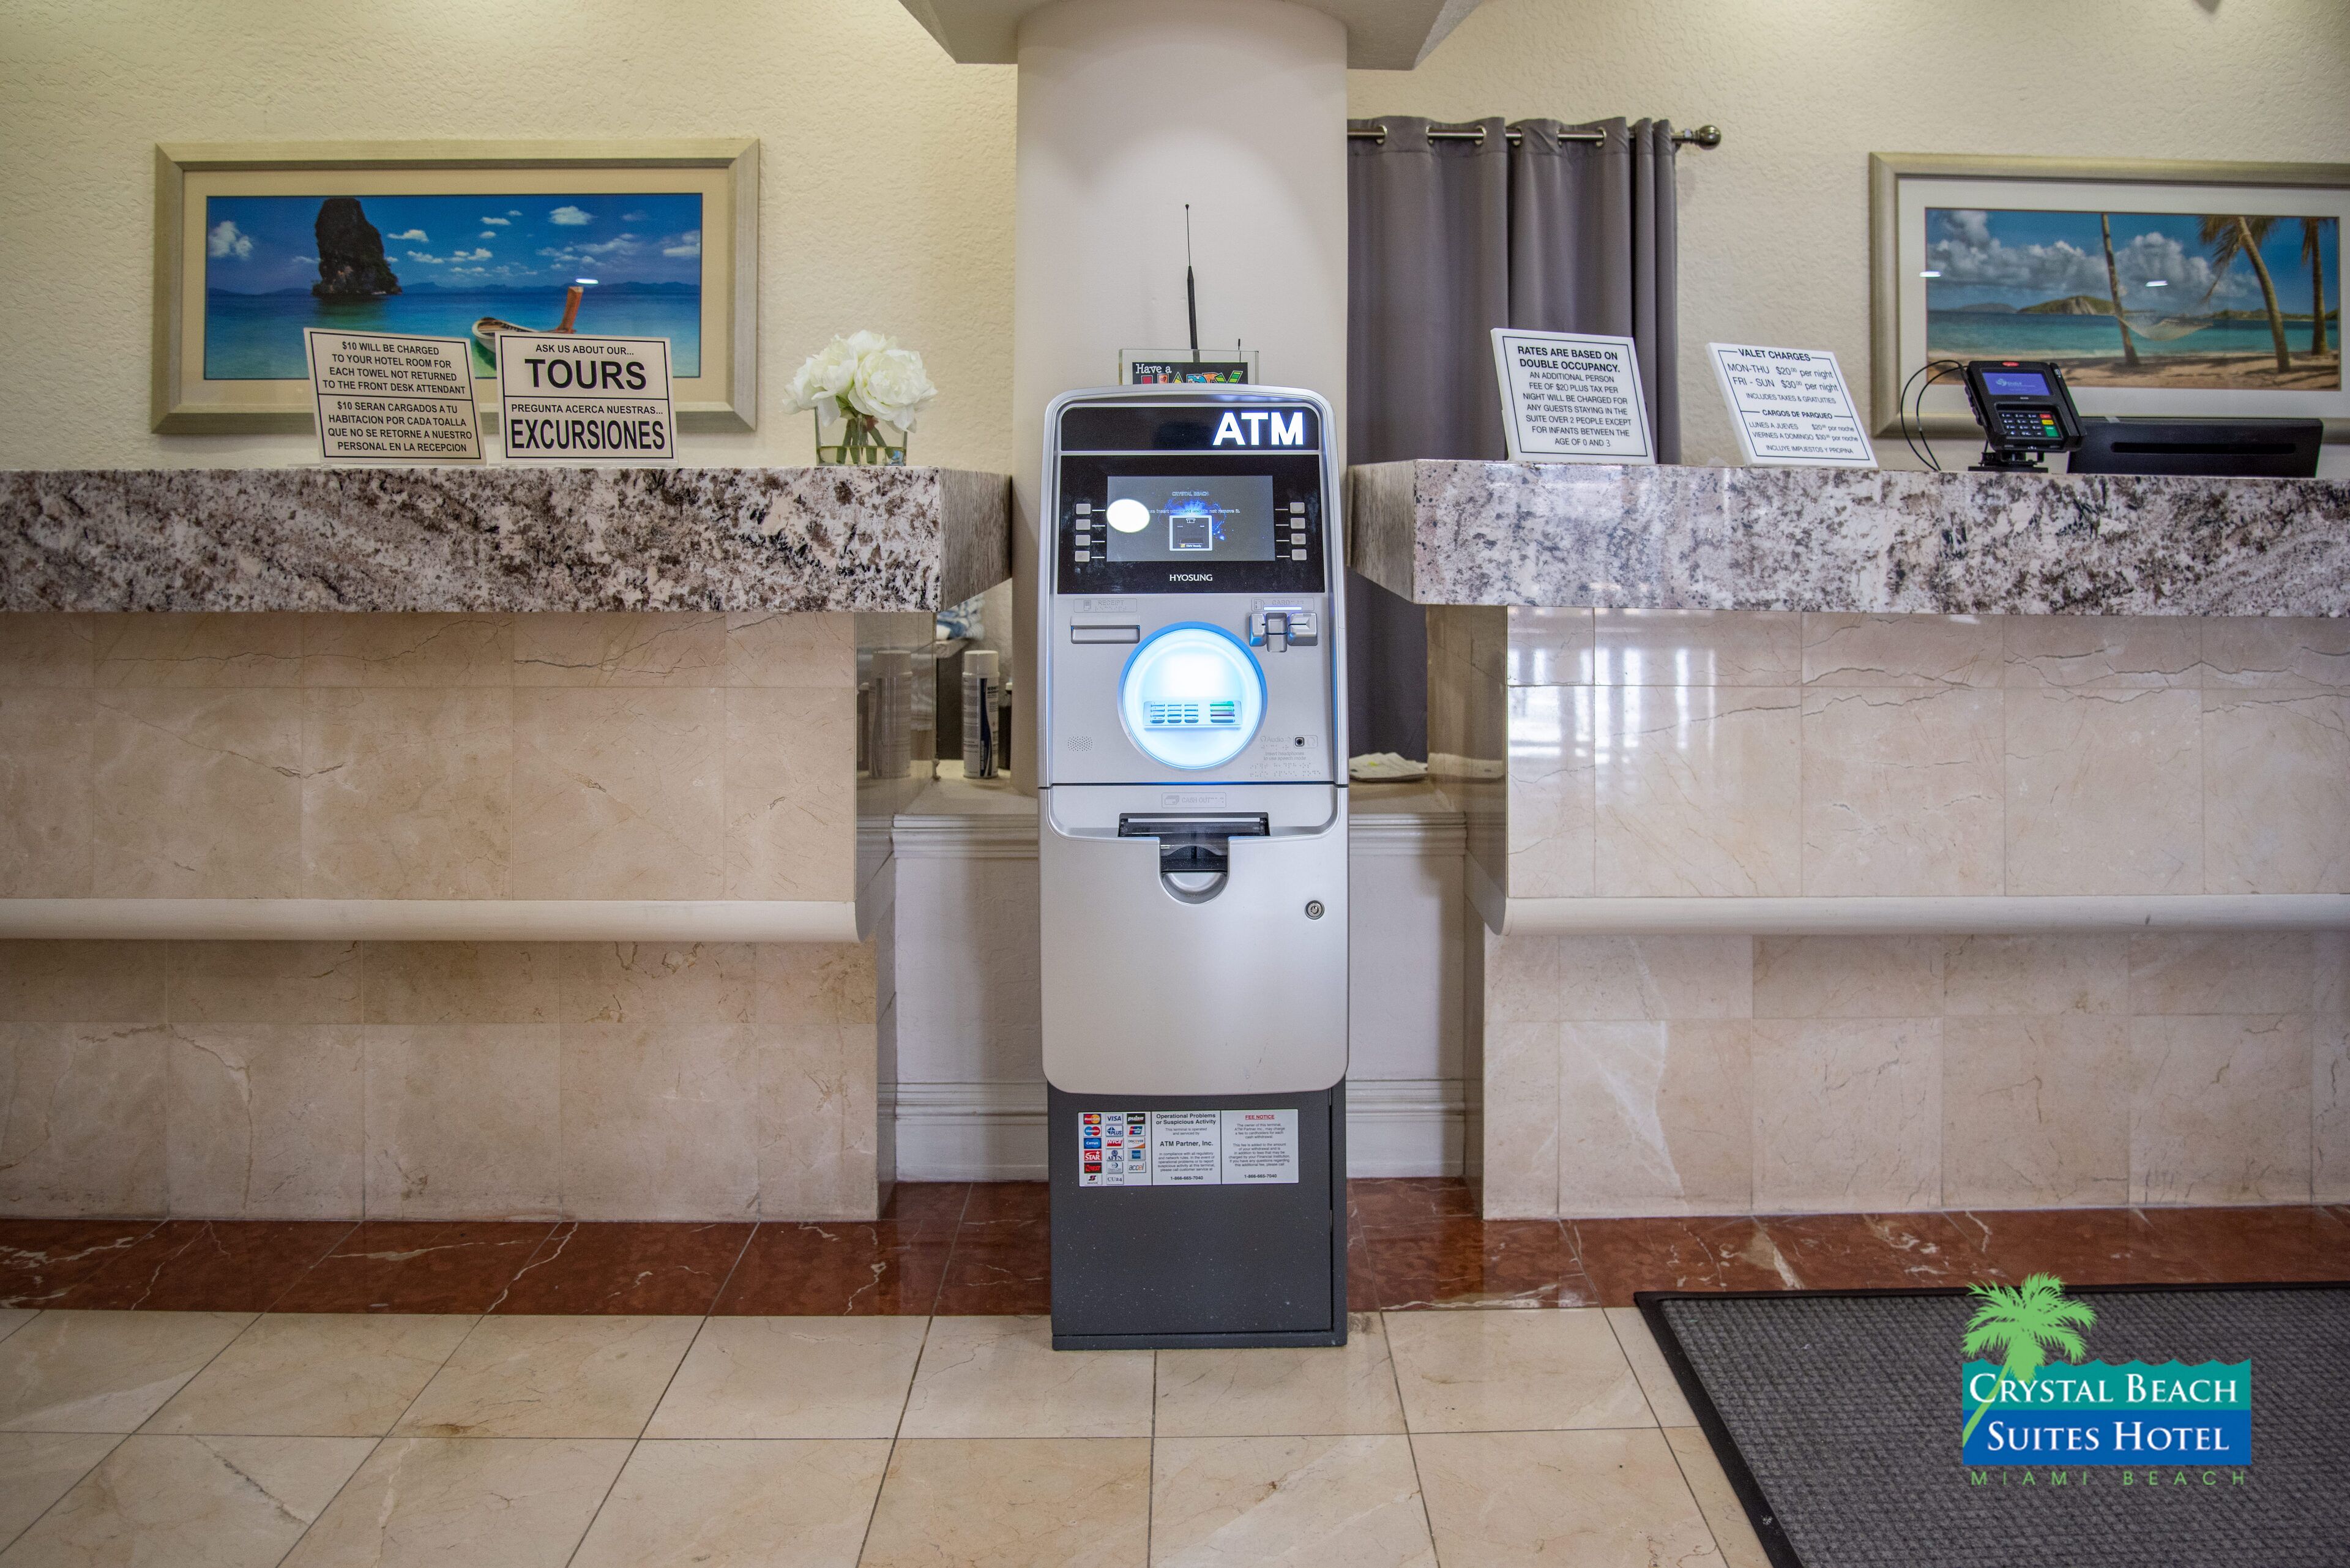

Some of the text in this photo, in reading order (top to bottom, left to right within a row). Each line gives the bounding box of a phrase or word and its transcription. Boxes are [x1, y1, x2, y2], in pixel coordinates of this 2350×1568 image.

[342, 341, 439, 356] $10 WILL BE CHARGED
[535, 344, 634, 355] ASK US ABOUT OUR...
[1517, 346, 1618, 360] RATES ARE BASED ON
[1738, 348, 1811, 362] VALET CHARGES
[331, 353, 452, 368] TO YOUR HOTEL ROOM FOR
[1519, 358, 1620, 373] DOUBLE OCCUPANCY.
[329, 367, 457, 381] EACH TOWEL NOT RETURNED
[524, 358, 647, 390] TOURS
[1136, 364, 1162, 374] Have
[1727, 363, 1770, 374] MON-THU
[1813, 370, 1833, 380] night
[1542, 372, 1584, 381] ADDITIONAL
[1585, 374, 1614, 383] PERSON
[322, 379, 466, 394] TO THE FRONT DESK ATTENDANT
[1556, 383, 1569, 392] $20
[1570, 384, 1589, 392] PLUS
[1732, 376, 1748, 386] FRI
[1755, 378, 1775, 387] SUN
[1819, 383, 1839, 393] night
[1523, 392, 1545, 401] NIGHT
[1576, 395, 1612, 404] CHARGED
[337, 401, 458, 414] $10 SERAN CARGADOS A TU
[511, 403, 663, 414] PREGUNTA ACERCA NUESTRAS...
[1543, 404, 1573, 413] GUESTS
[1573, 405, 1604, 414] STAYING
[1762, 409, 1791, 417] CARGOS
[328, 414, 467, 427] HABITACION POR CADA TOALLA
[1526, 414, 1547, 423] SUITE
[1548, 415, 1569, 424] OVER
[327, 428, 472, 439] QUE NO SE RETORNE A NUESTRO
[510, 419, 665, 450] EXCURSIONES
[1213, 413, 1304, 446] ATM
[1548, 427, 1579, 435] INFANTS
[1580, 427, 1615, 436] BETWEEN
[337, 441, 467, 452] PERSONAL EN LA RECEPCION
[1605, 439, 1611, 447] 3
